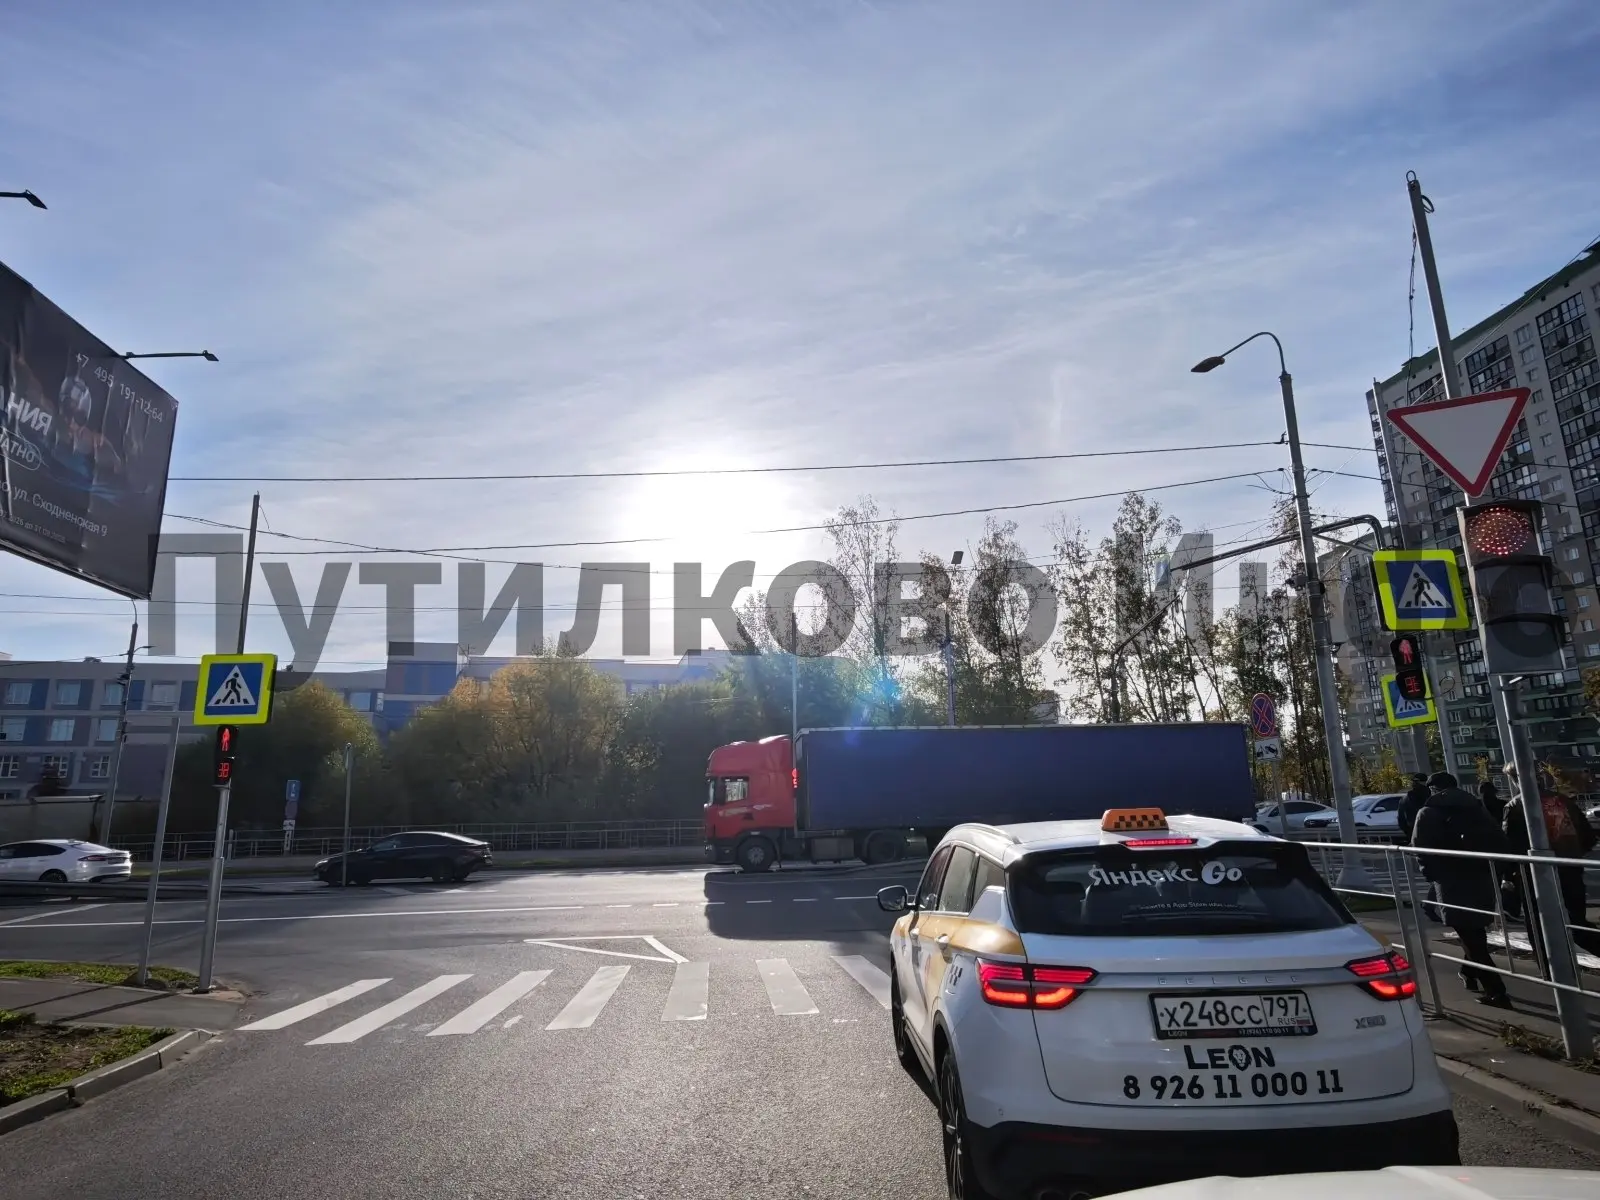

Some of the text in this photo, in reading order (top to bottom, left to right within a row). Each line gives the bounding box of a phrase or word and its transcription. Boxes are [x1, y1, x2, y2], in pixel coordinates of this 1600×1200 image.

[76, 353, 89, 368] +7
[94, 366, 114, 388] 495
[32, 493, 100, 534] Сходненская
[101, 524, 108, 536] 9
[1088, 861, 1242, 886] Яндекс Go
[1263, 996, 1299, 1017] 797
[1184, 1045, 1276, 1071] LEON
[1123, 1069, 1344, 1099] 8 926 11 000 11
